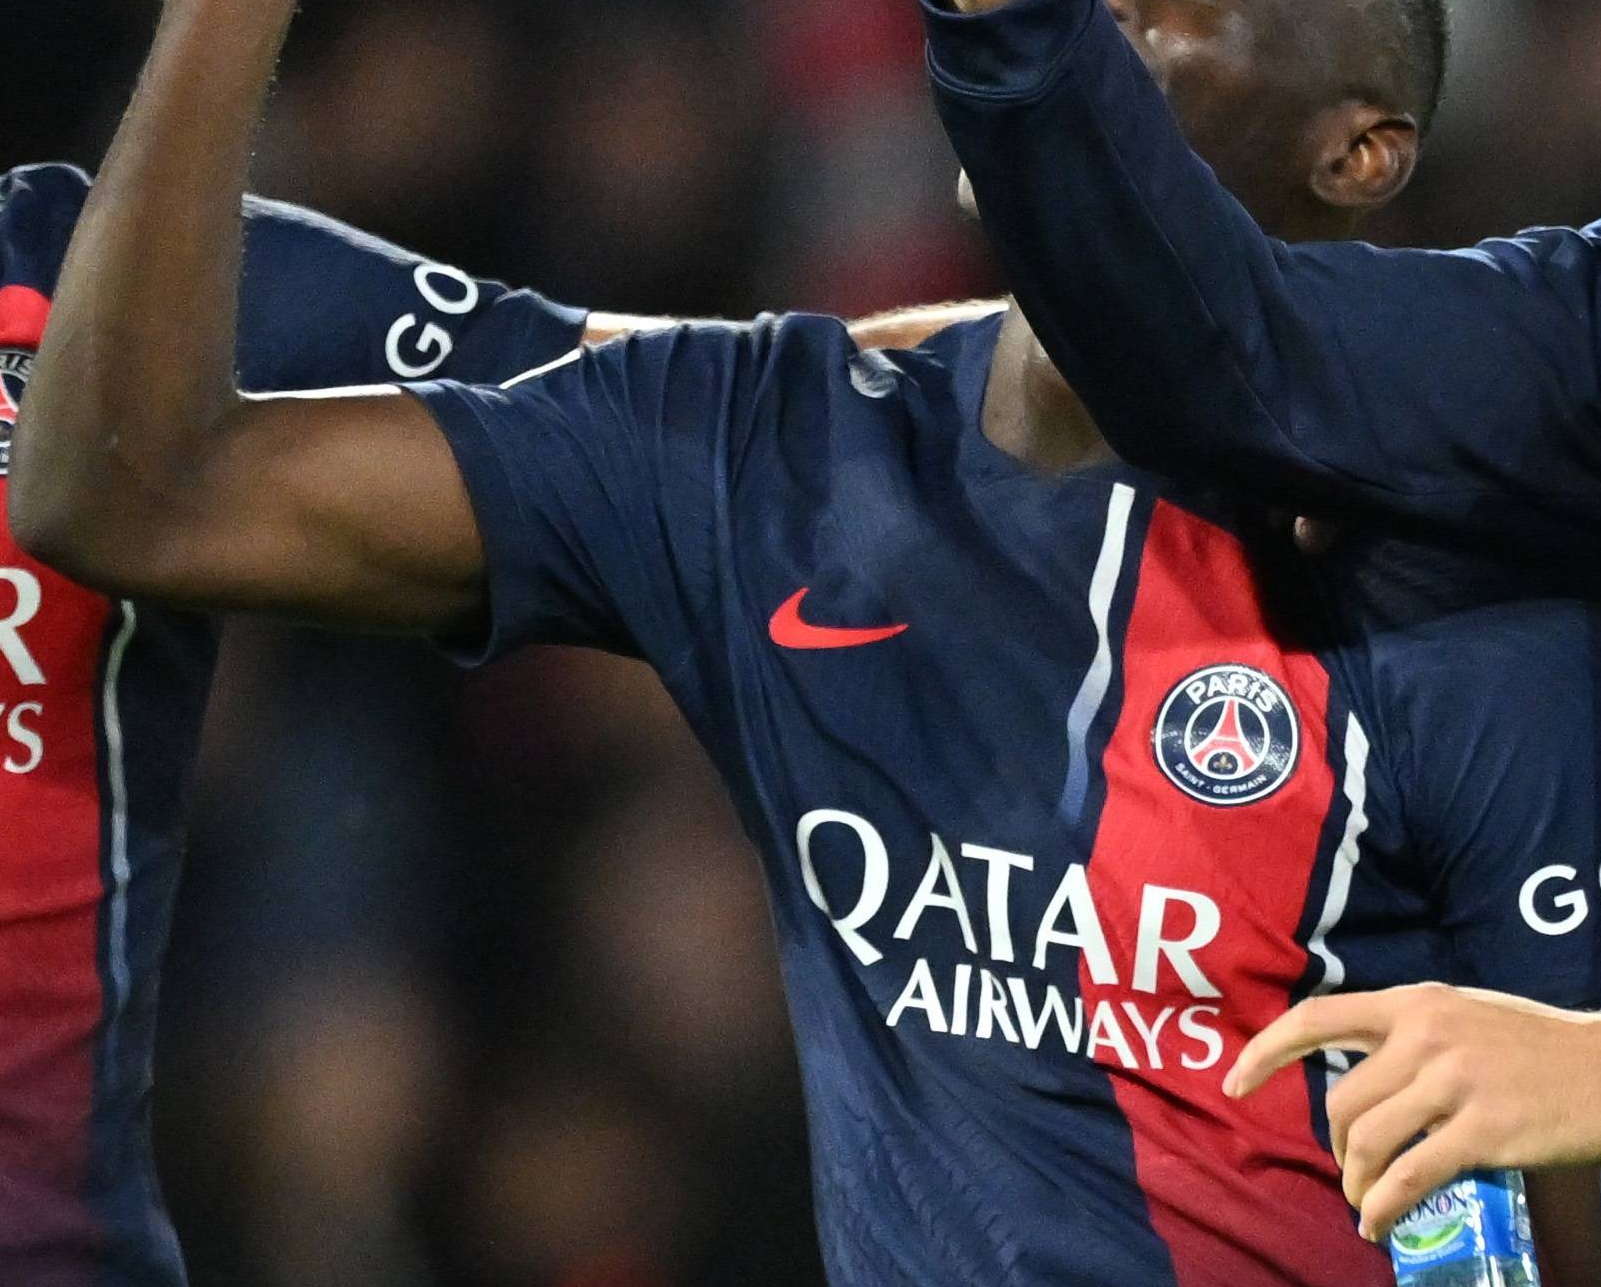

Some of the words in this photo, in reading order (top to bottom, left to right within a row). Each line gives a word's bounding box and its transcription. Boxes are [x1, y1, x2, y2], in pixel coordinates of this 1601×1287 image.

[1185, 673, 1280, 713] PARIS
[797, 808, 1221, 999] QATAR
[885, 958, 1224, 1071] AIRWAYS
